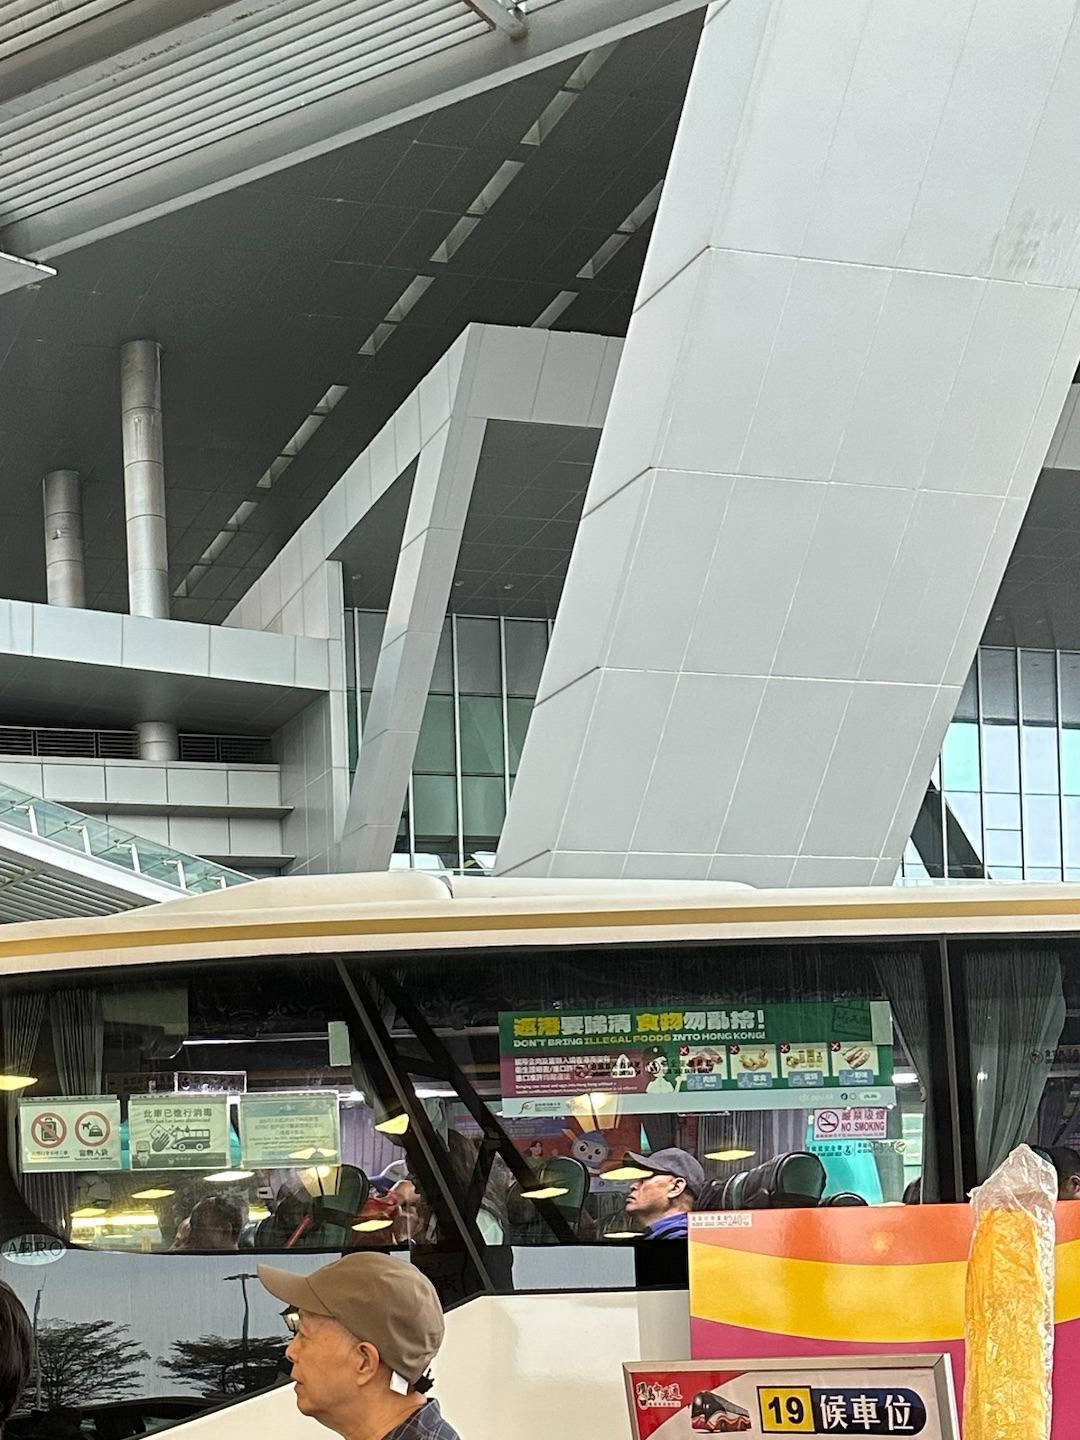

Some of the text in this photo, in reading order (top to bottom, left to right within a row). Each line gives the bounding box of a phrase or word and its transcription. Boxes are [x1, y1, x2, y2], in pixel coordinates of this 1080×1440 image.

[514, 1039, 546, 1047] DON'T
[548, 1038, 583, 1046] BRING
[584, 1035, 631, 1044] ILLEGAL
[633, 1034, 670, 1042] FOODS
[672, 1033, 701, 1041] INTO
[701, 1032, 732, 1040] HONG
[841, 1121, 885, 1131] NO SMOKING
[7, 1240, 62, 1257] AERO
[767, 1394, 915, 1431] 19 候車位
